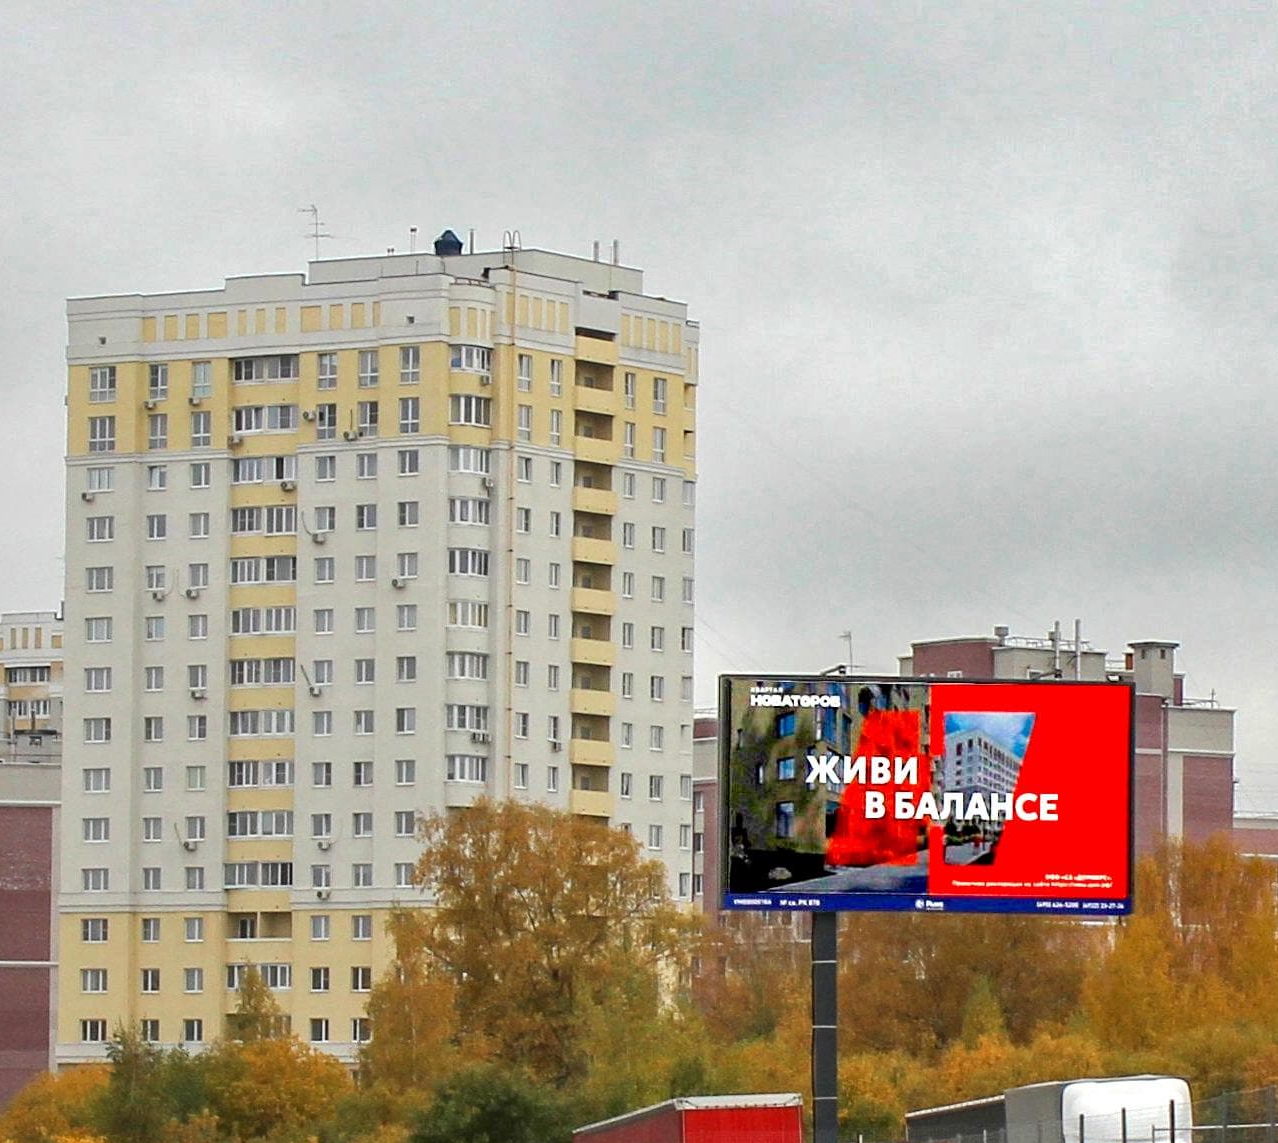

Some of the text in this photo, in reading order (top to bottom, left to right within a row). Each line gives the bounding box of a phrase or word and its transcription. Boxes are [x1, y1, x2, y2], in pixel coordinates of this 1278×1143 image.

[750, 694, 841, 708] НОВАТОРОВ
[805, 755, 918, 785] ЖИВИ
[865, 791, 1059, 821] В БАЛАНСЕ
